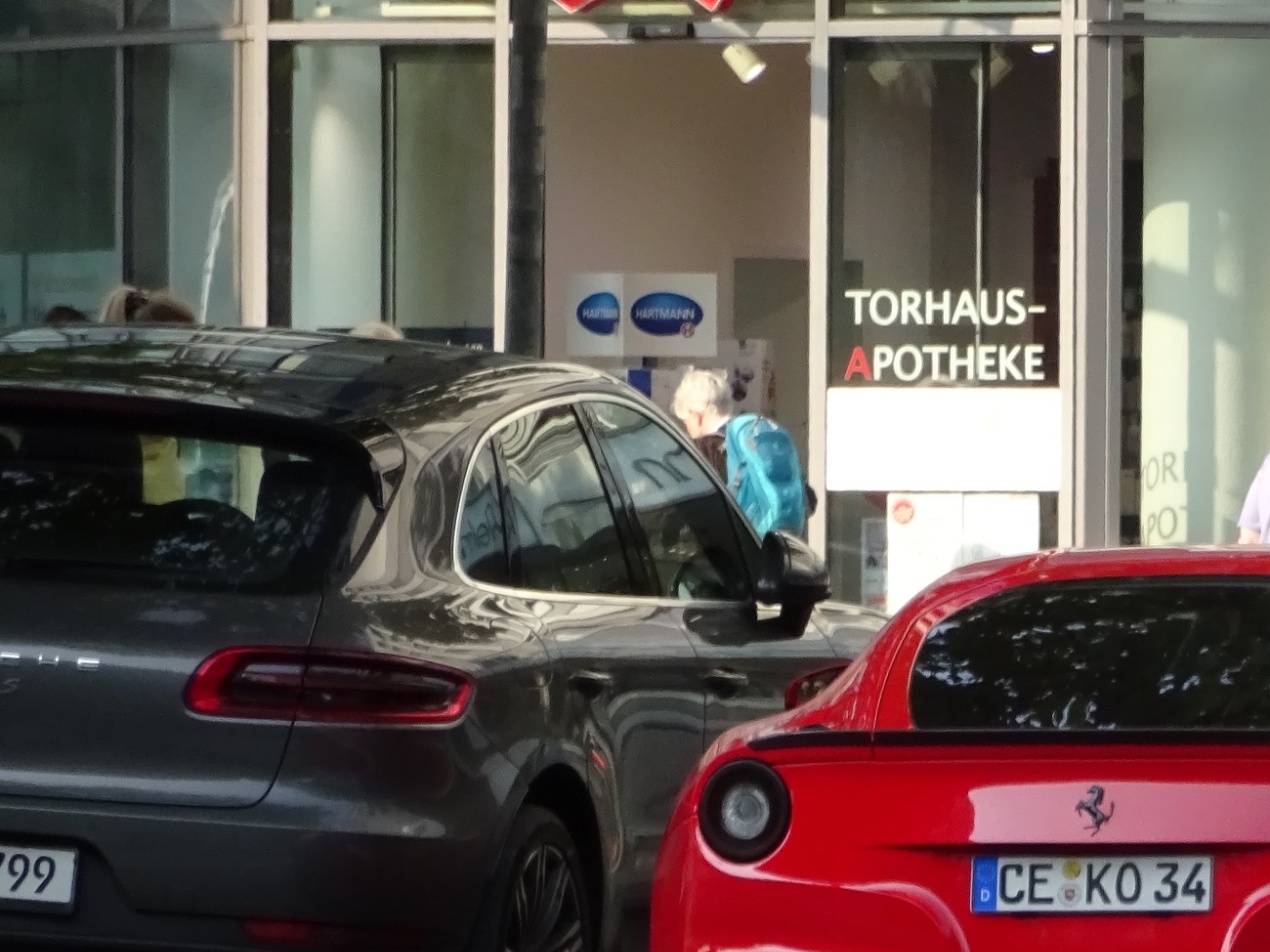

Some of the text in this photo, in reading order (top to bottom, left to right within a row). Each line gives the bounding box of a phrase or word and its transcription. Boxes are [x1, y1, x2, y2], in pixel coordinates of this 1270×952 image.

[635, 308, 695, 321] HARTMANN
[844, 288, 1047, 326] TORHAUS-
[844, 344, 1045, 382] APOTHEKE
[0, 852, 56, 894] 99
[1000, 863, 1054, 905] CE
[1086, 862, 1142, 905] KO
[1154, 862, 1206, 904] 34
